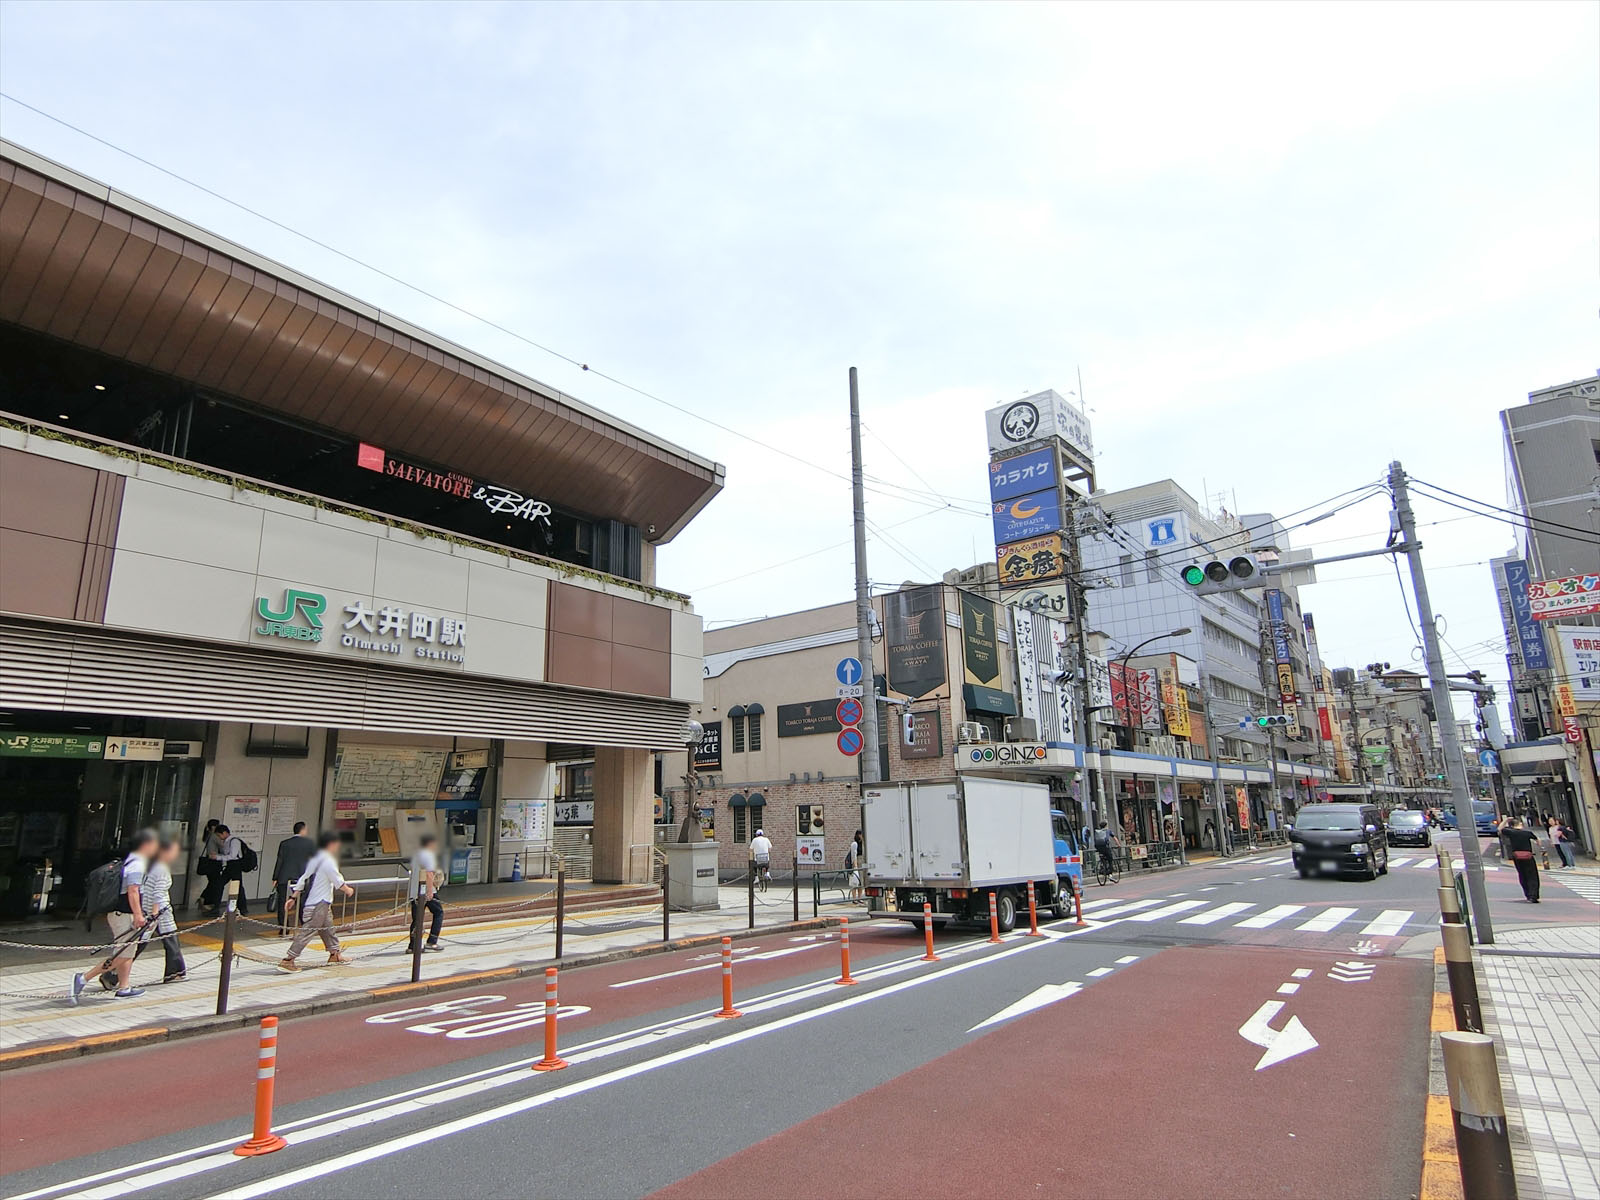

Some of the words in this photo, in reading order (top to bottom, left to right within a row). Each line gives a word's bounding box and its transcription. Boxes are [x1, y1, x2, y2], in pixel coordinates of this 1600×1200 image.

[994, 462, 1049, 487] カラオケ
[386, 459, 473, 499] SALVATORE
[473, 487, 487, 500] &
[486, 485, 552, 526] BAR
[1004, 550, 1057, 578] 金の蔵
[1528, 575, 1600, 600] カラオケ
[257, 588, 327, 627] JR
[1509, 566, 1542, 657] アイザワ証券
[257, 621, 323, 642] JR東日本
[342, 600, 467, 647] 大井町駅
[415, 647, 465, 663] Station
[893, 644, 916, 653] TORAJA
[915, 640, 938, 650] COFFEE
[839, 687, 860, 696] 8-20
[1138, 671, 1154, 714] ラーメン
[8, 736, 29, 746] JR
[31, 737, 63, 745] 大井町駅
